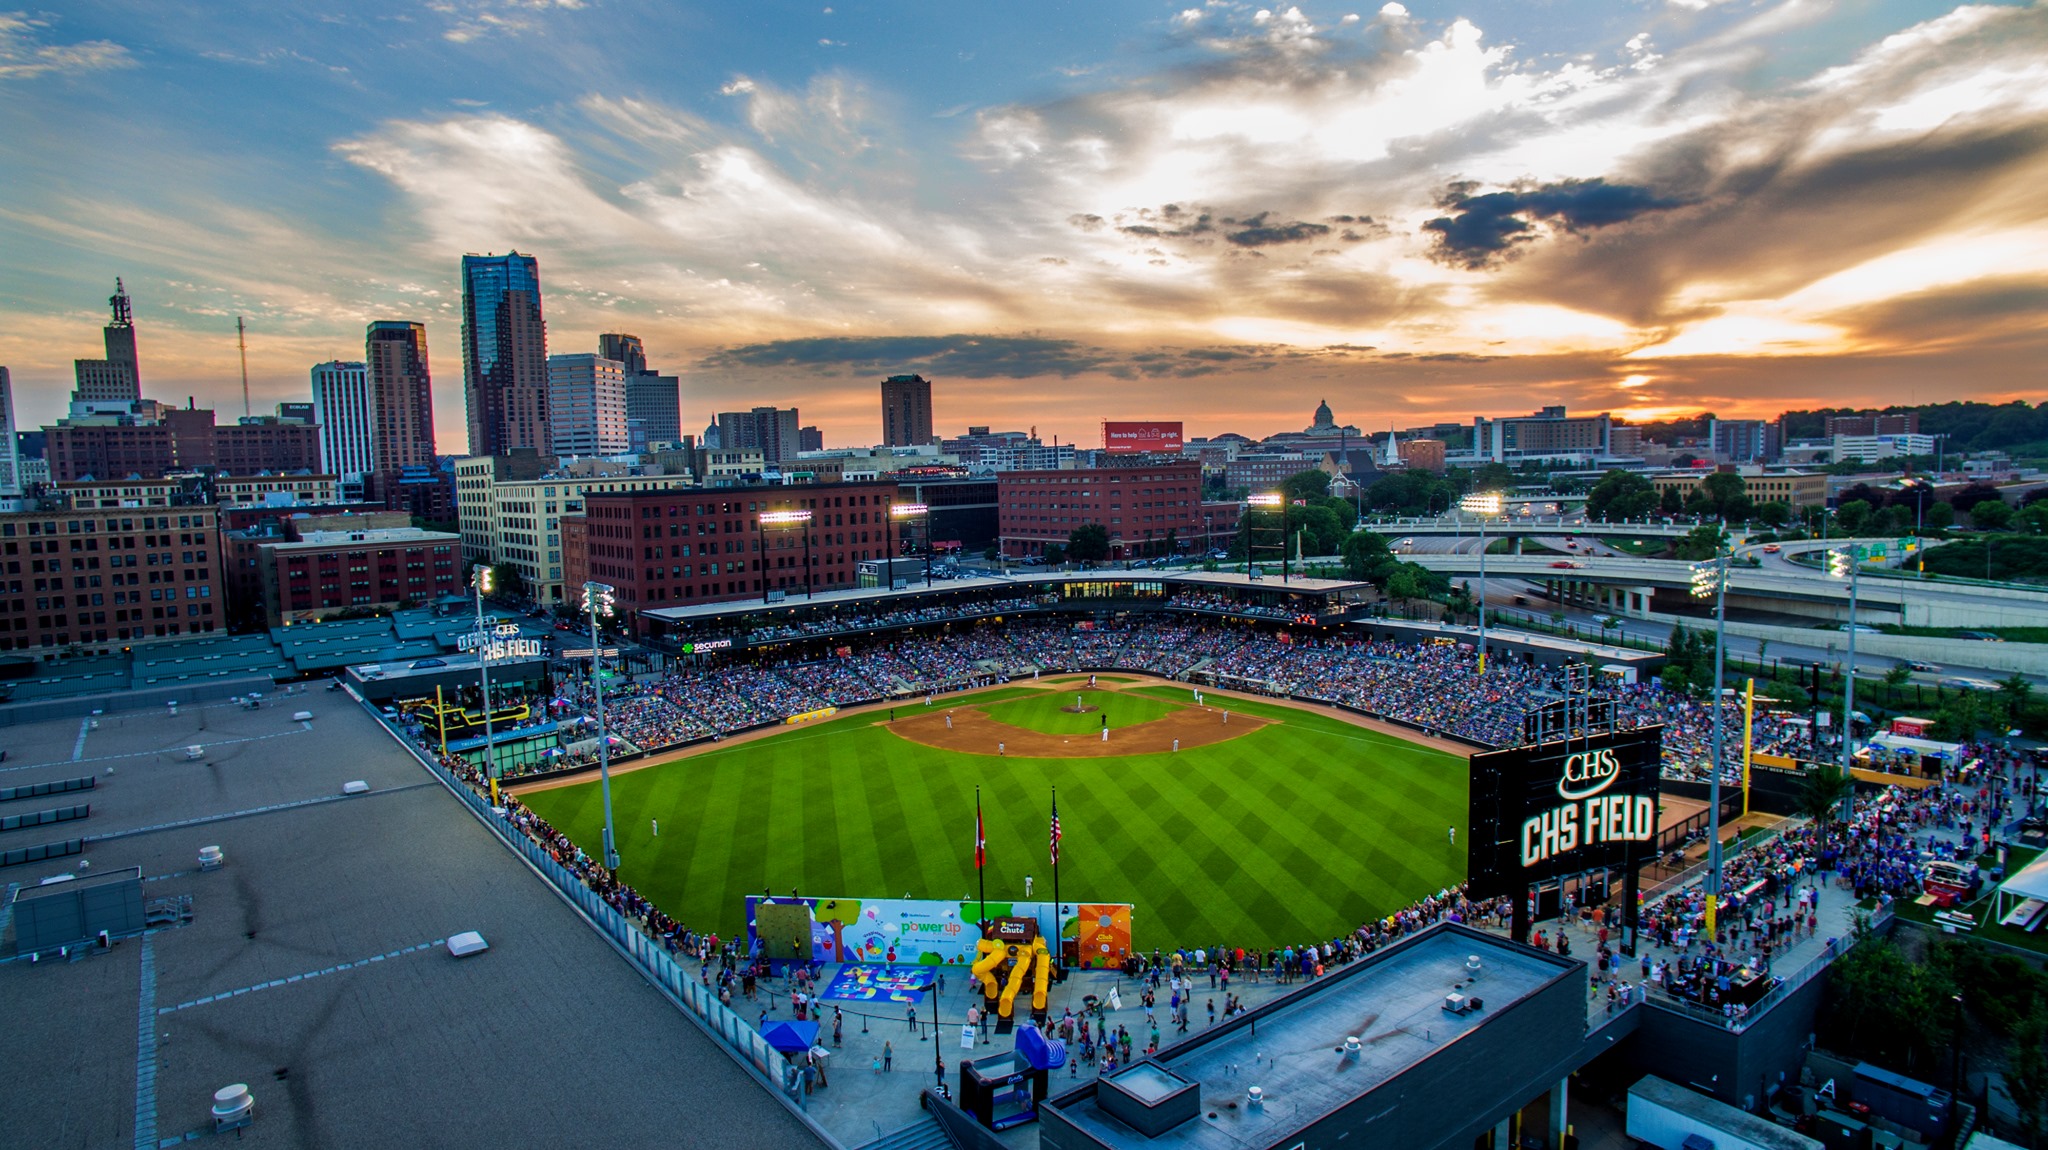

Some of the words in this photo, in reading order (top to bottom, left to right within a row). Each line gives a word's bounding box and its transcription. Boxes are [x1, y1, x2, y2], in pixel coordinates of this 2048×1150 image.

[496, 623, 520, 635] CHS
[507, 639, 541, 657] FIELD
[461, 739, 486, 747] TREASURE
[1565, 749, 1614, 782] CHS
[1784, 769, 1807, 777] CORNER
[1522, 803, 1578, 867] CHS
[1584, 795, 1654, 845] FIELD
[1000, 926, 1025, 934] Chute
